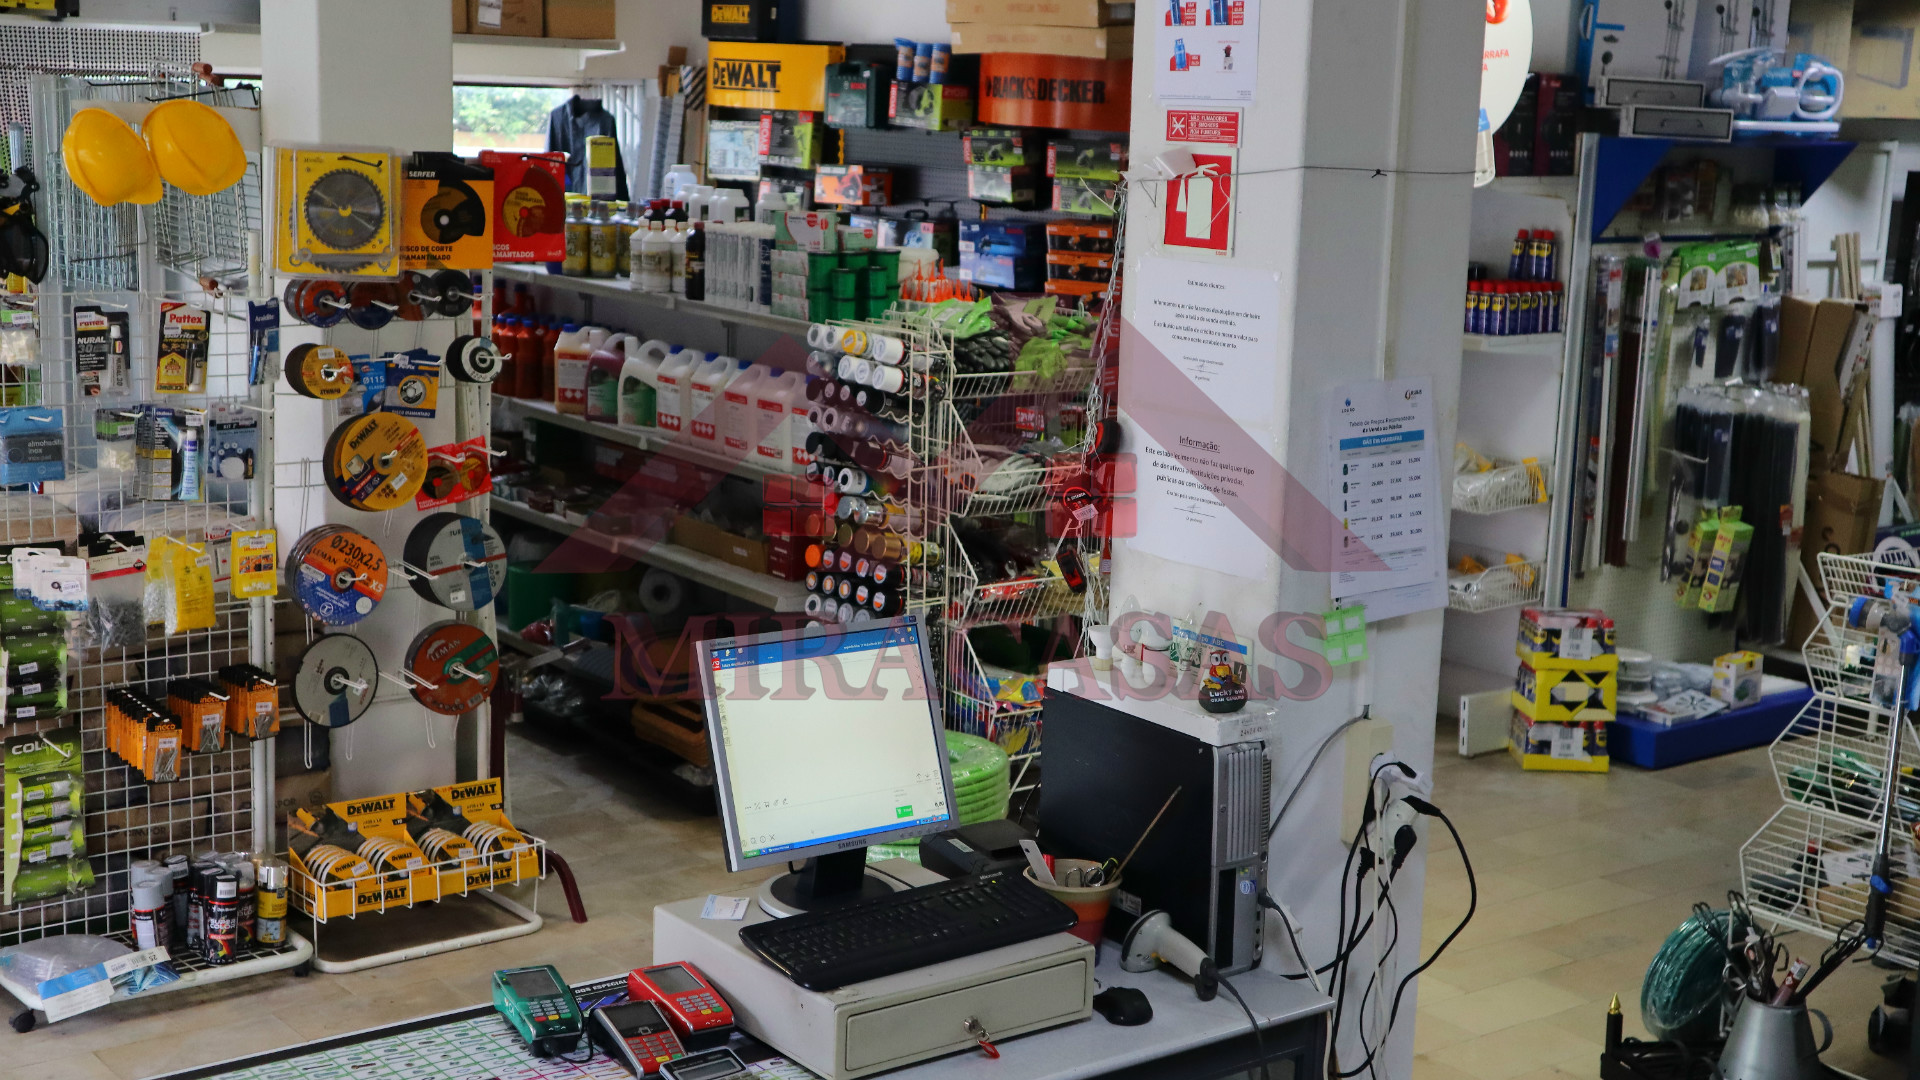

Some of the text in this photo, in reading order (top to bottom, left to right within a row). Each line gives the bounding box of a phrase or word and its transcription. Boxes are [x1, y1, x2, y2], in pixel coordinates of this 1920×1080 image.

[711, 5, 749, 22] DEWALT
[712, 60, 781, 89] DEWALT
[408, 170, 436, 178] SERFER
[493, 243, 510, 251] SCOS
[493, 251, 535, 259] AMANTADOS
[168, 313, 202, 324] Pattex
[77, 336, 106, 345] NURAL
[78, 343, 94, 354] 30
[348, 418, 380, 451] DEWALT
[1179, 435, 1221, 452] Informação:
[312, 548, 338, 566] LEMAN
[330, 534, 383, 572] Ø230x2,5
[1212, 639, 1225, 647] ABC
[430, 640, 461, 662] LEMAN
[1209, 688, 1233, 698] Lucky
[452, 783, 497, 799] DEWALT
[347, 798, 396, 815] DEWALT
[837, 838, 867, 849] SAMSUNG
[391, 852, 412, 861] DEWALT
[335, 861, 356, 873] DEWALT
[466, 867, 512, 886] DEWALT
[357, 886, 407, 905] DEWALT
